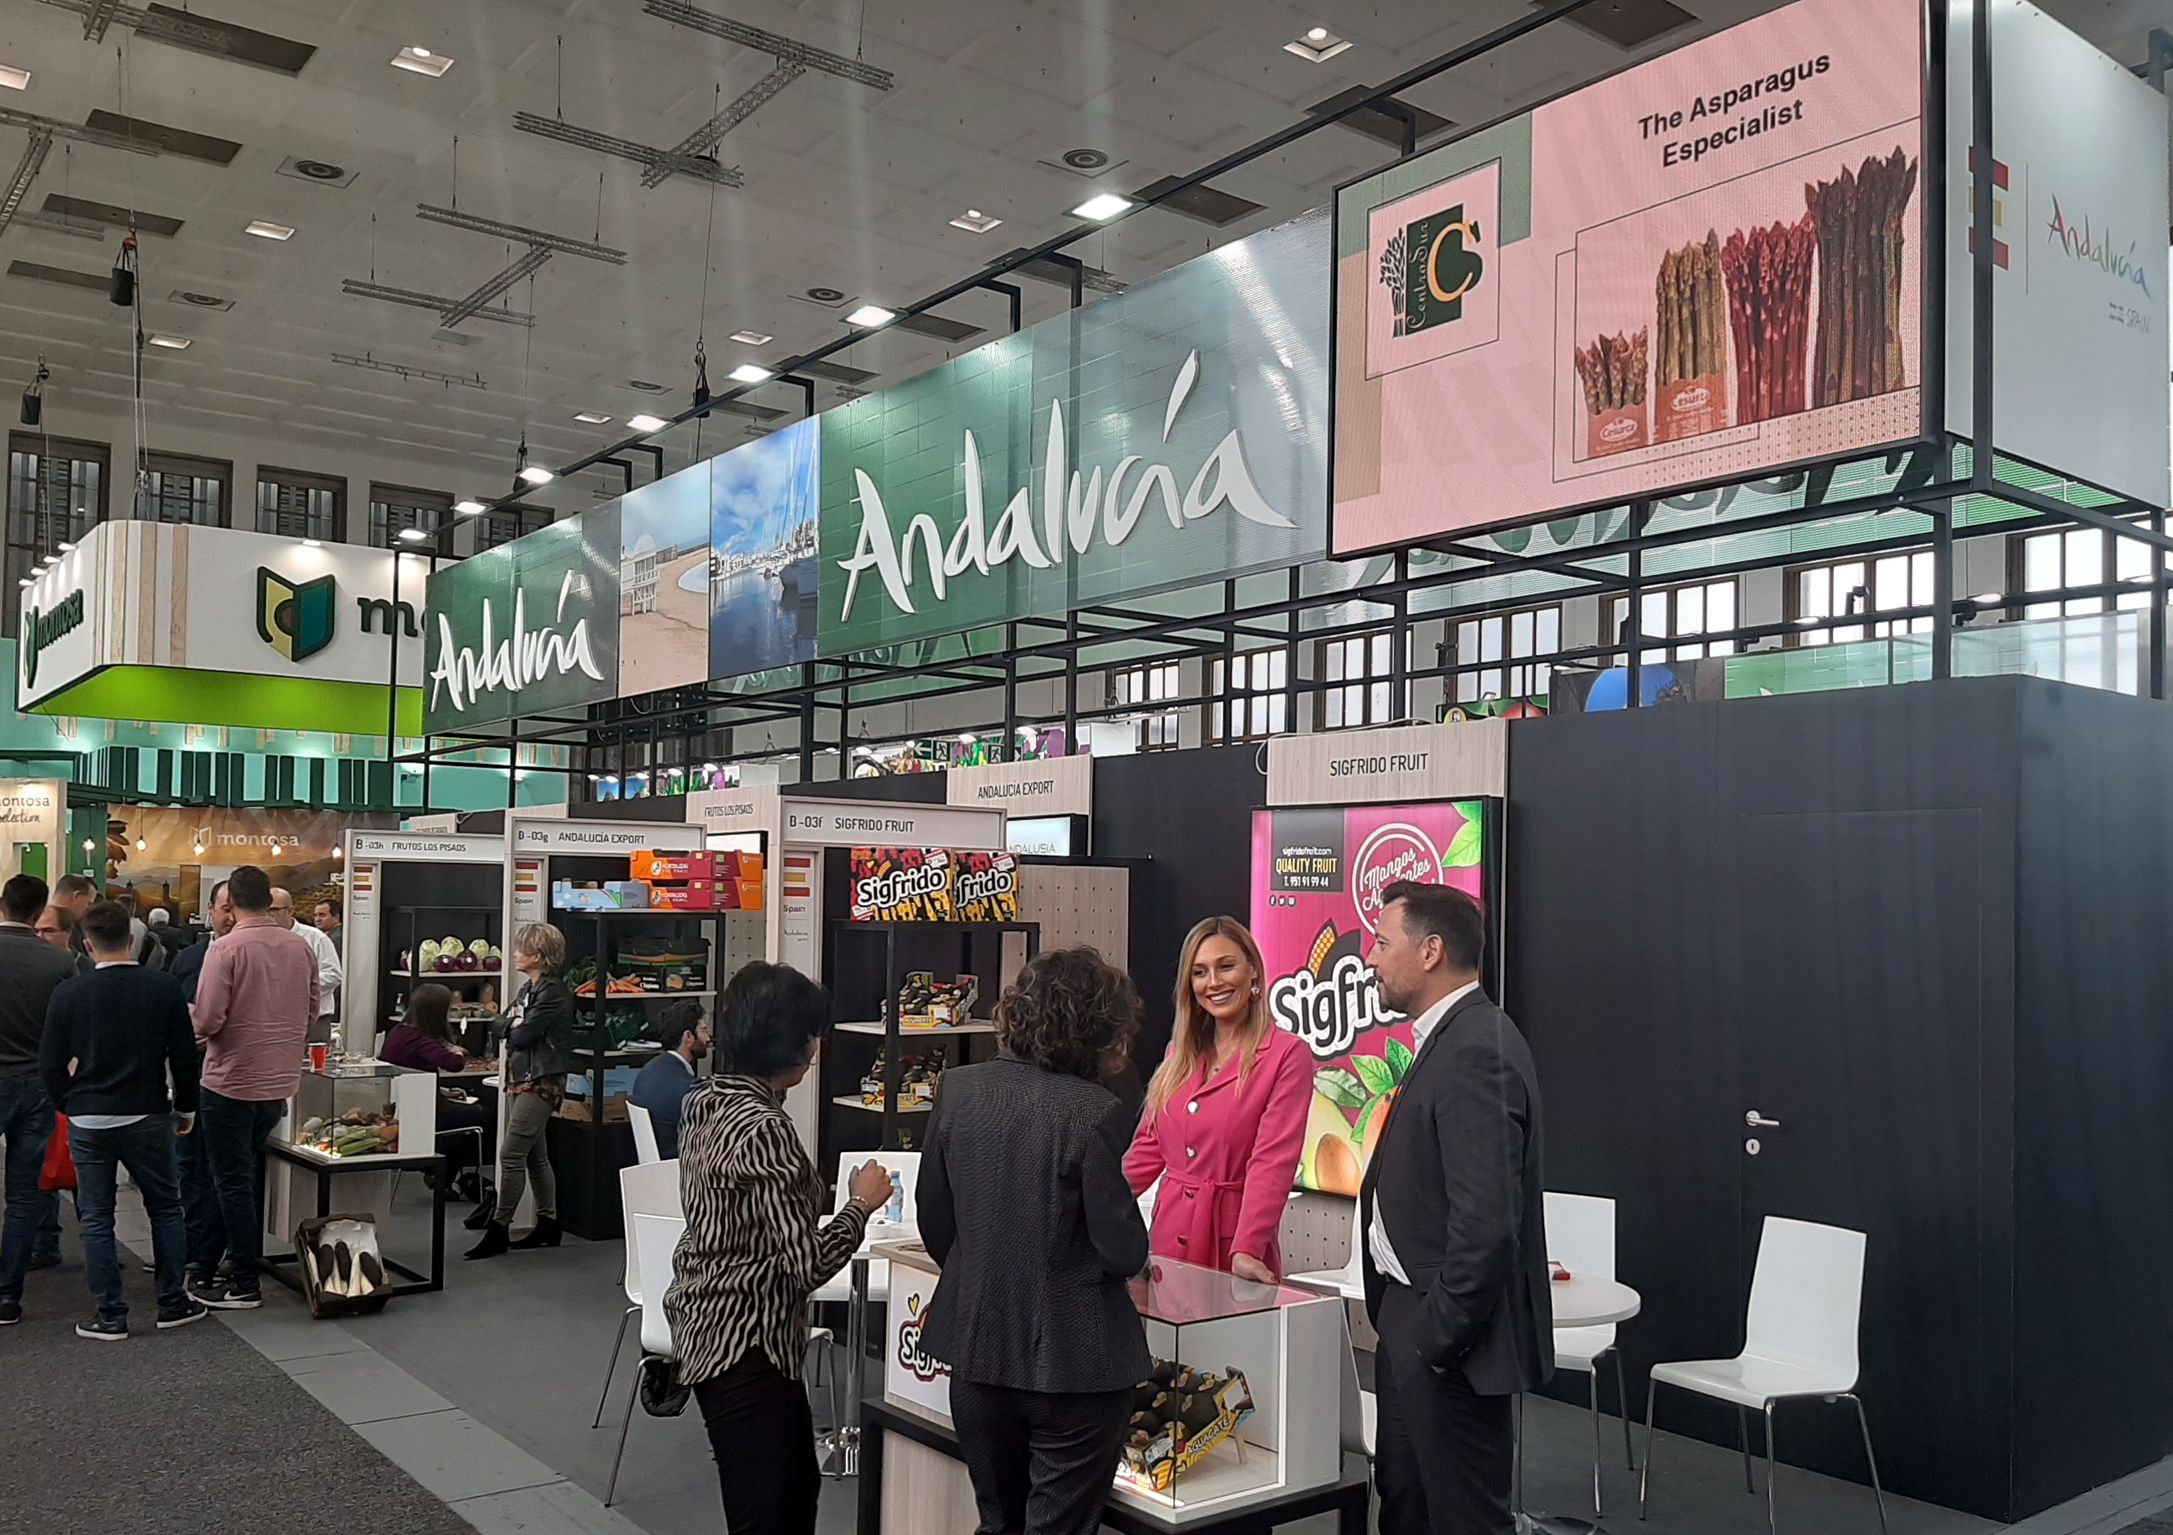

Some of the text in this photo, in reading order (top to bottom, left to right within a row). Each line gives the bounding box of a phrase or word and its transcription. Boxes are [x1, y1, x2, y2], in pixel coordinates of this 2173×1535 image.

[1638, 54, 1831, 140] The Asparagus
[1663, 99, 1804, 168] Especialist
[2046, 193, 2152, 299] Andalucía
[836, 348, 1300, 623] Andalucía
[430, 569, 605, 712] Andalucía
[1330, 753, 1429, 777] SIGFRIDO FRUIT
[0, 797, 50, 807] ontosa
[977, 780, 1054, 799] ANDALUCÍA EXPORT
[217, 831, 300, 847] montosa
[611, 834, 645, 845] EXPORT
[834, 817, 882, 831] SIGFRIDO
[885, 819, 914, 833] FRUIT
[1009, 842, 1056, 854] NDALUSIA
[1275, 858, 1338, 875] QUALITY FRUIT
[1302, 876, 1310, 887] 91
[1320, 876, 1329, 887] 44
[1364, 847, 1417, 890] Mangos
[858, 864, 944, 907] Sigfrido
[1274, 960, 1383, 1048] Sigfr
[1186, 1414, 1230, 1456] AGUACATE
